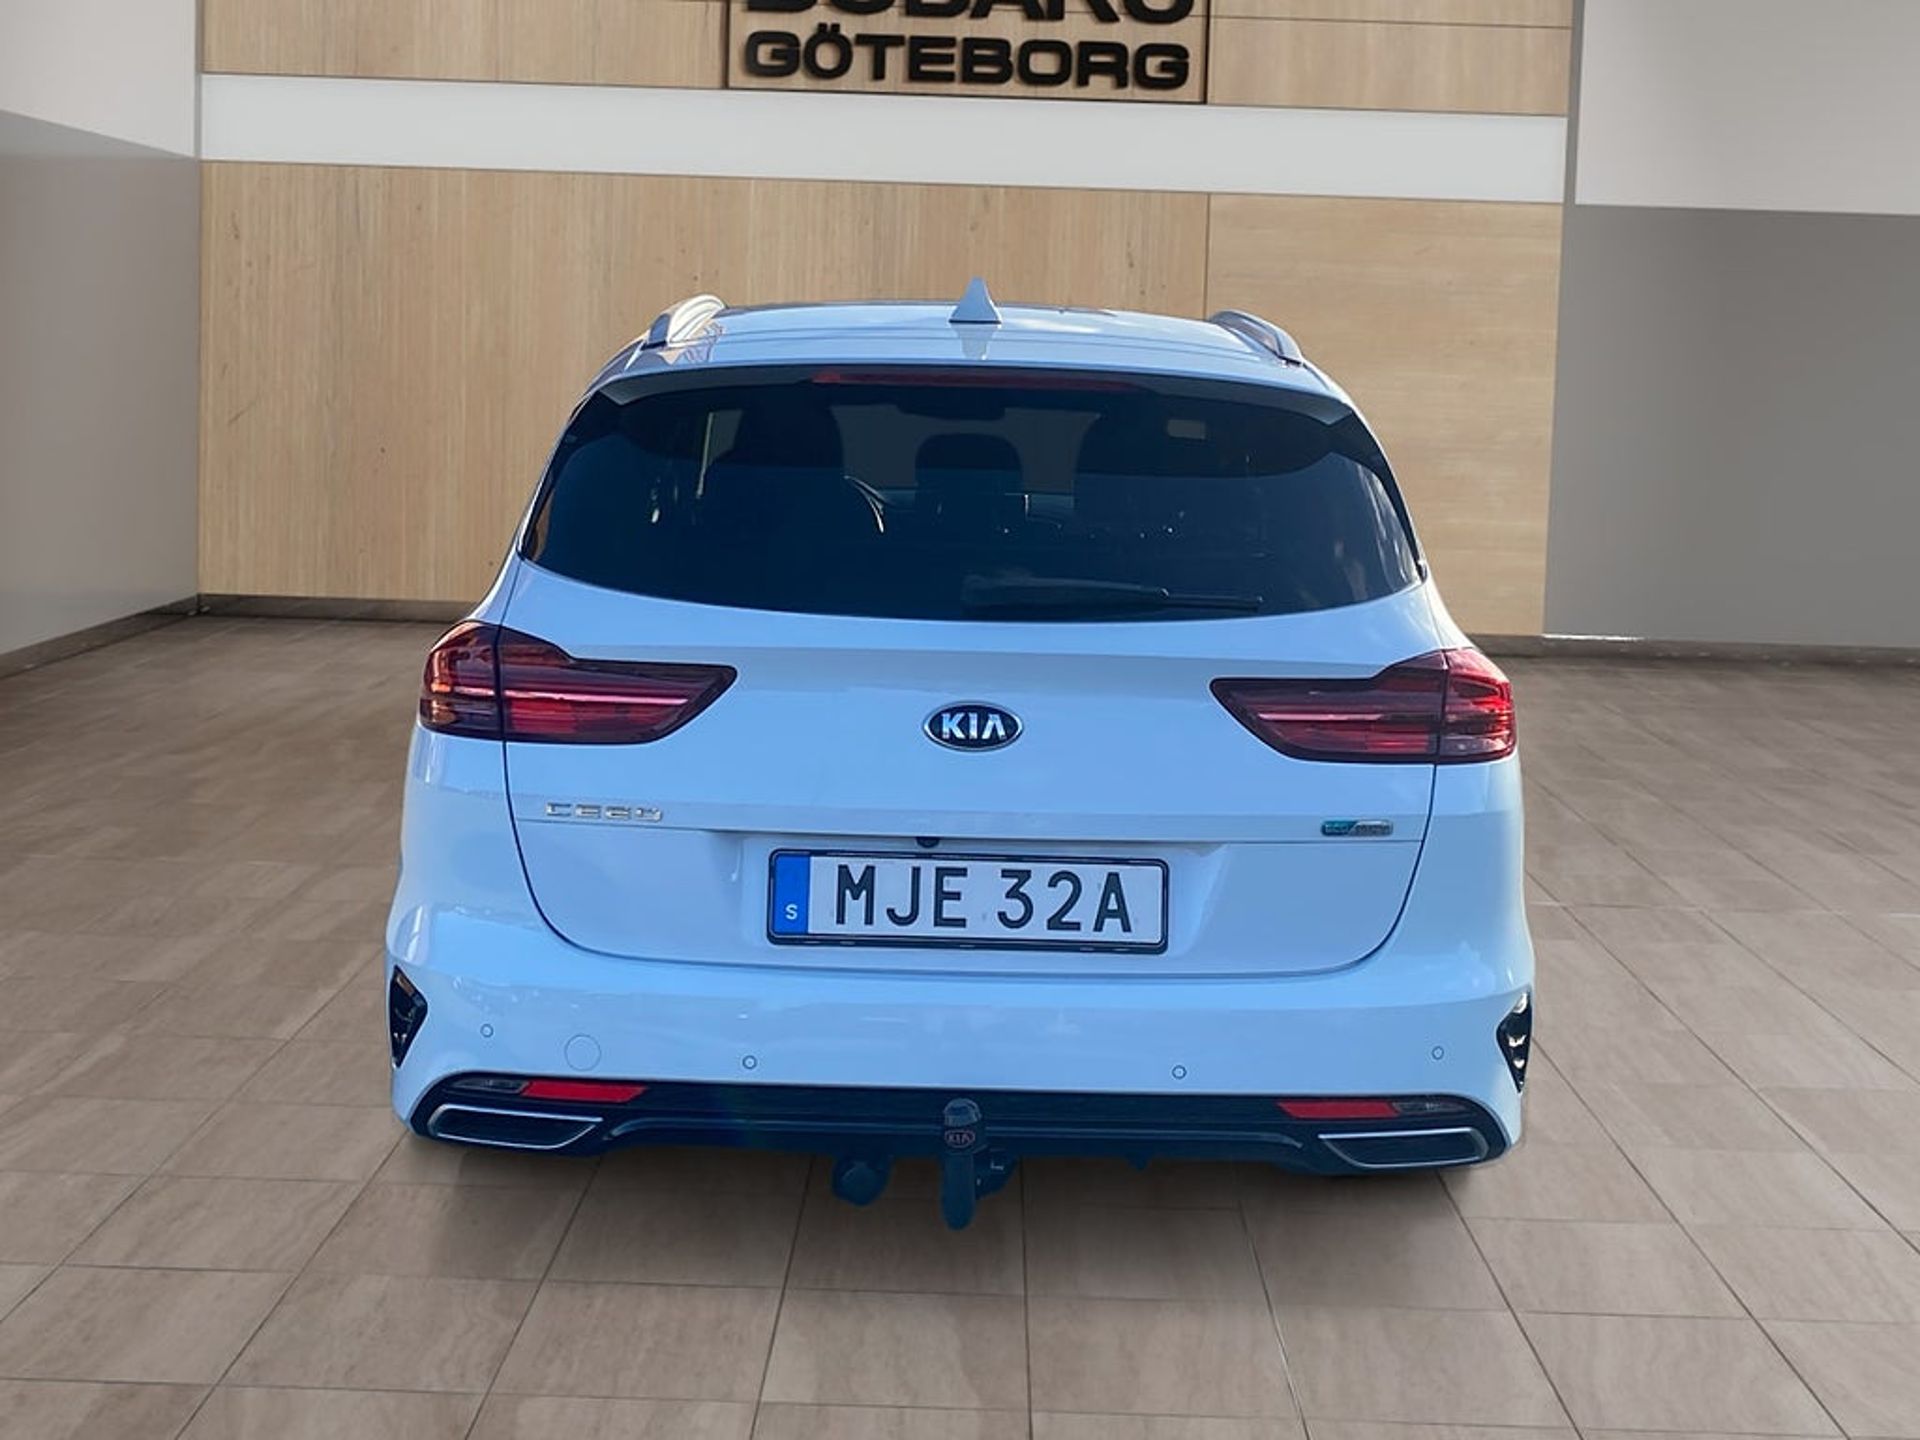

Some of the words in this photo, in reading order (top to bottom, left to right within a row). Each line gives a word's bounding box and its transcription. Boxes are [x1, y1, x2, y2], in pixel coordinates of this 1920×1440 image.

[744, 24, 1190, 90] GÖTEBORG
[941, 712, 1007, 740] KIA
[785, 903, 798, 921] S
[835, 864, 968, 928] MJE
[997, 868, 1133, 933] 32A
